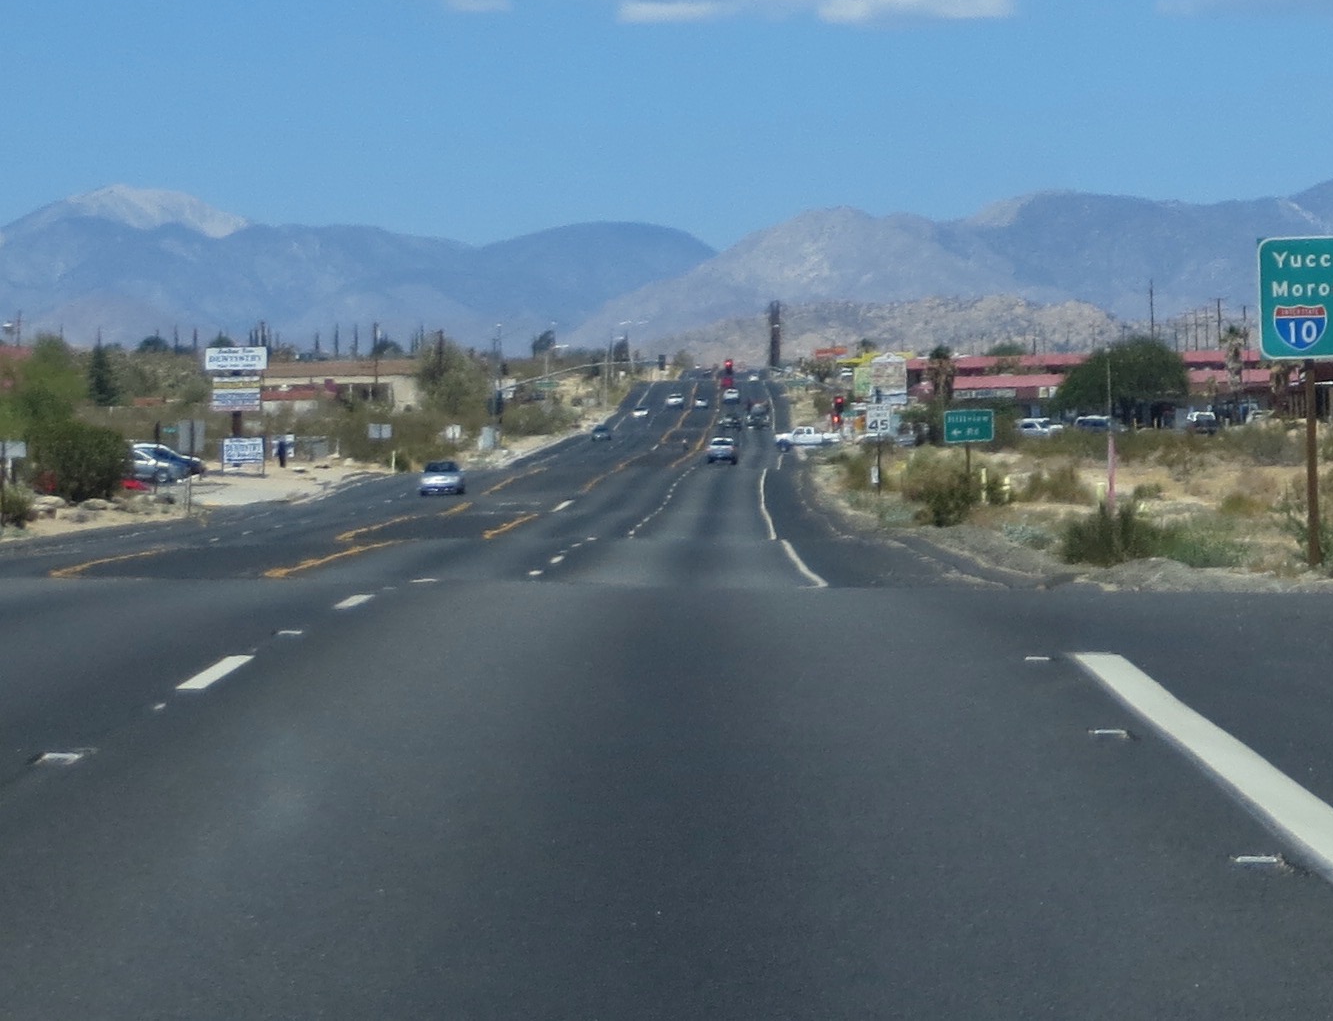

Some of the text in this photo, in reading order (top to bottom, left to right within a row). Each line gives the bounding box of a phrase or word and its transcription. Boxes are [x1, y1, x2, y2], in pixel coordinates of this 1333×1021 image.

[1281, 307, 1320, 316] INTERSTATE
[1289, 320, 1317, 343] 10
[868, 419, 888, 431] 45
